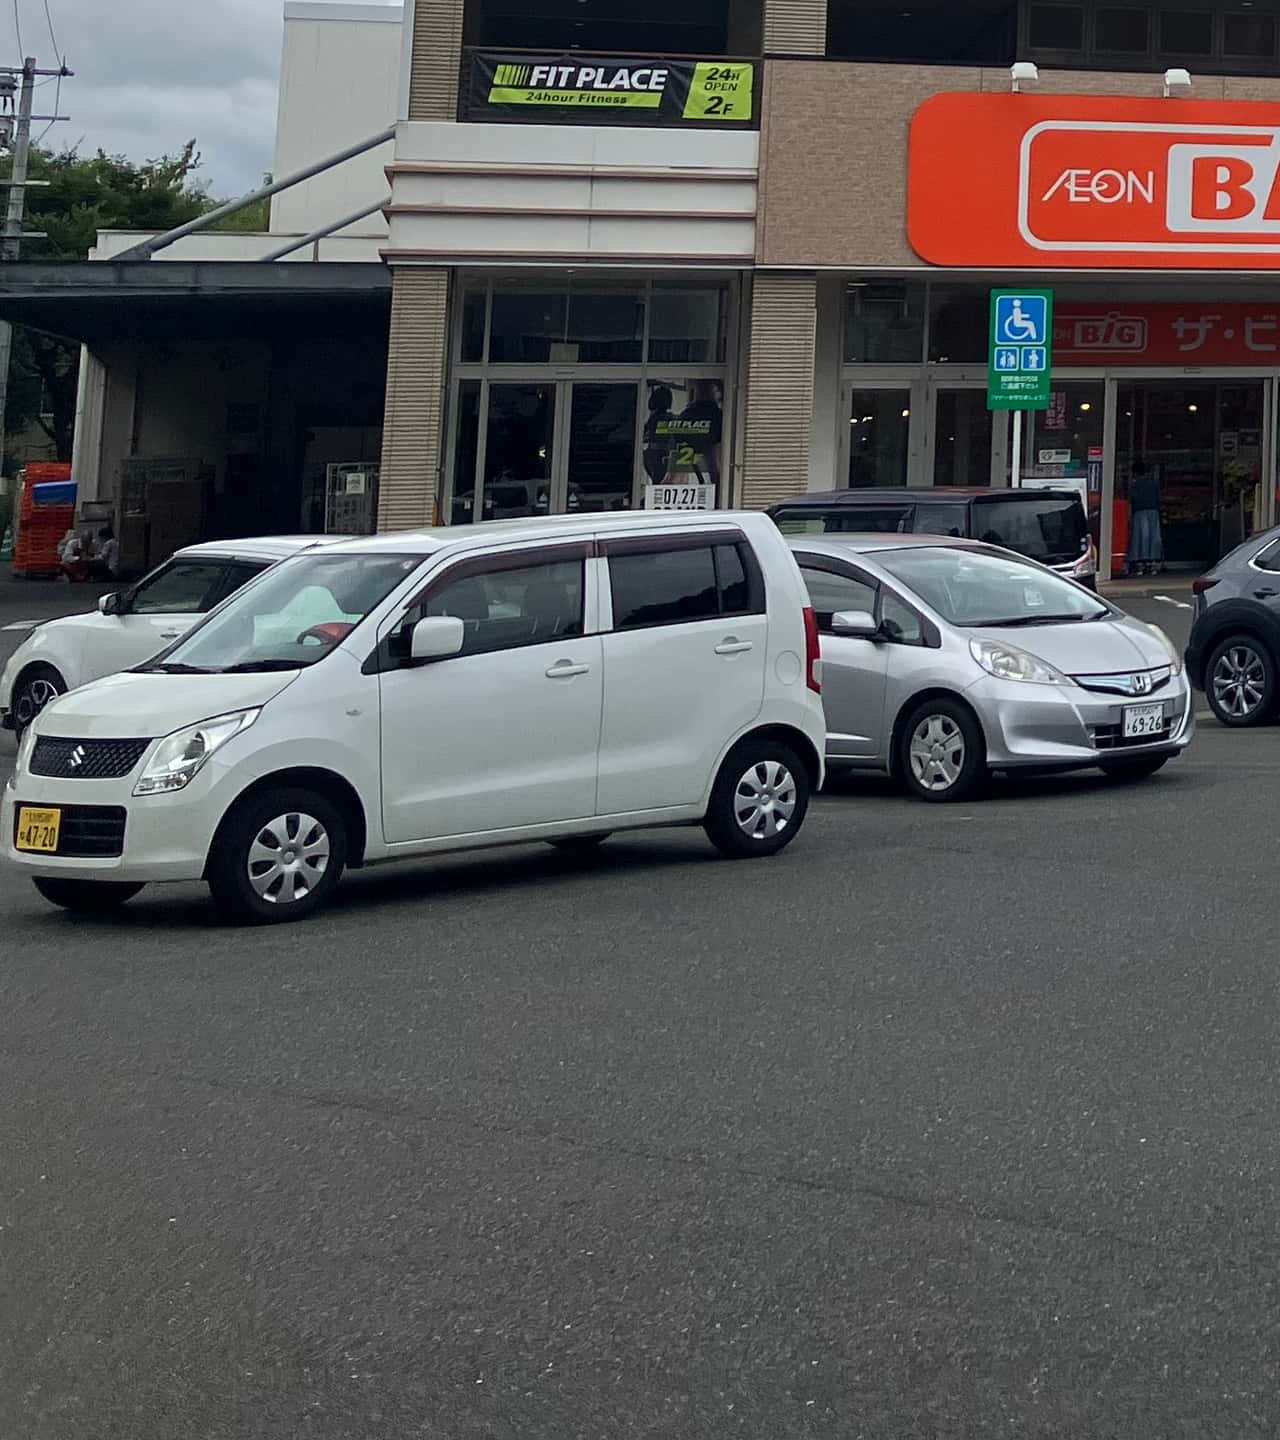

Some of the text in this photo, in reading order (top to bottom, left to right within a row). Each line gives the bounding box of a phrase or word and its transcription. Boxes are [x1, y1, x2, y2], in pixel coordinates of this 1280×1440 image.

[530, 65, 669, 91] FIT PLACE
[704, 81, 738, 92] OPEN
[525, 91, 627, 104] 24hour Fitness
[704, 96, 734, 116] 2F
[1132, 715, 1161, 733] 69-26
[26, 825, 56, 847] 47-20
